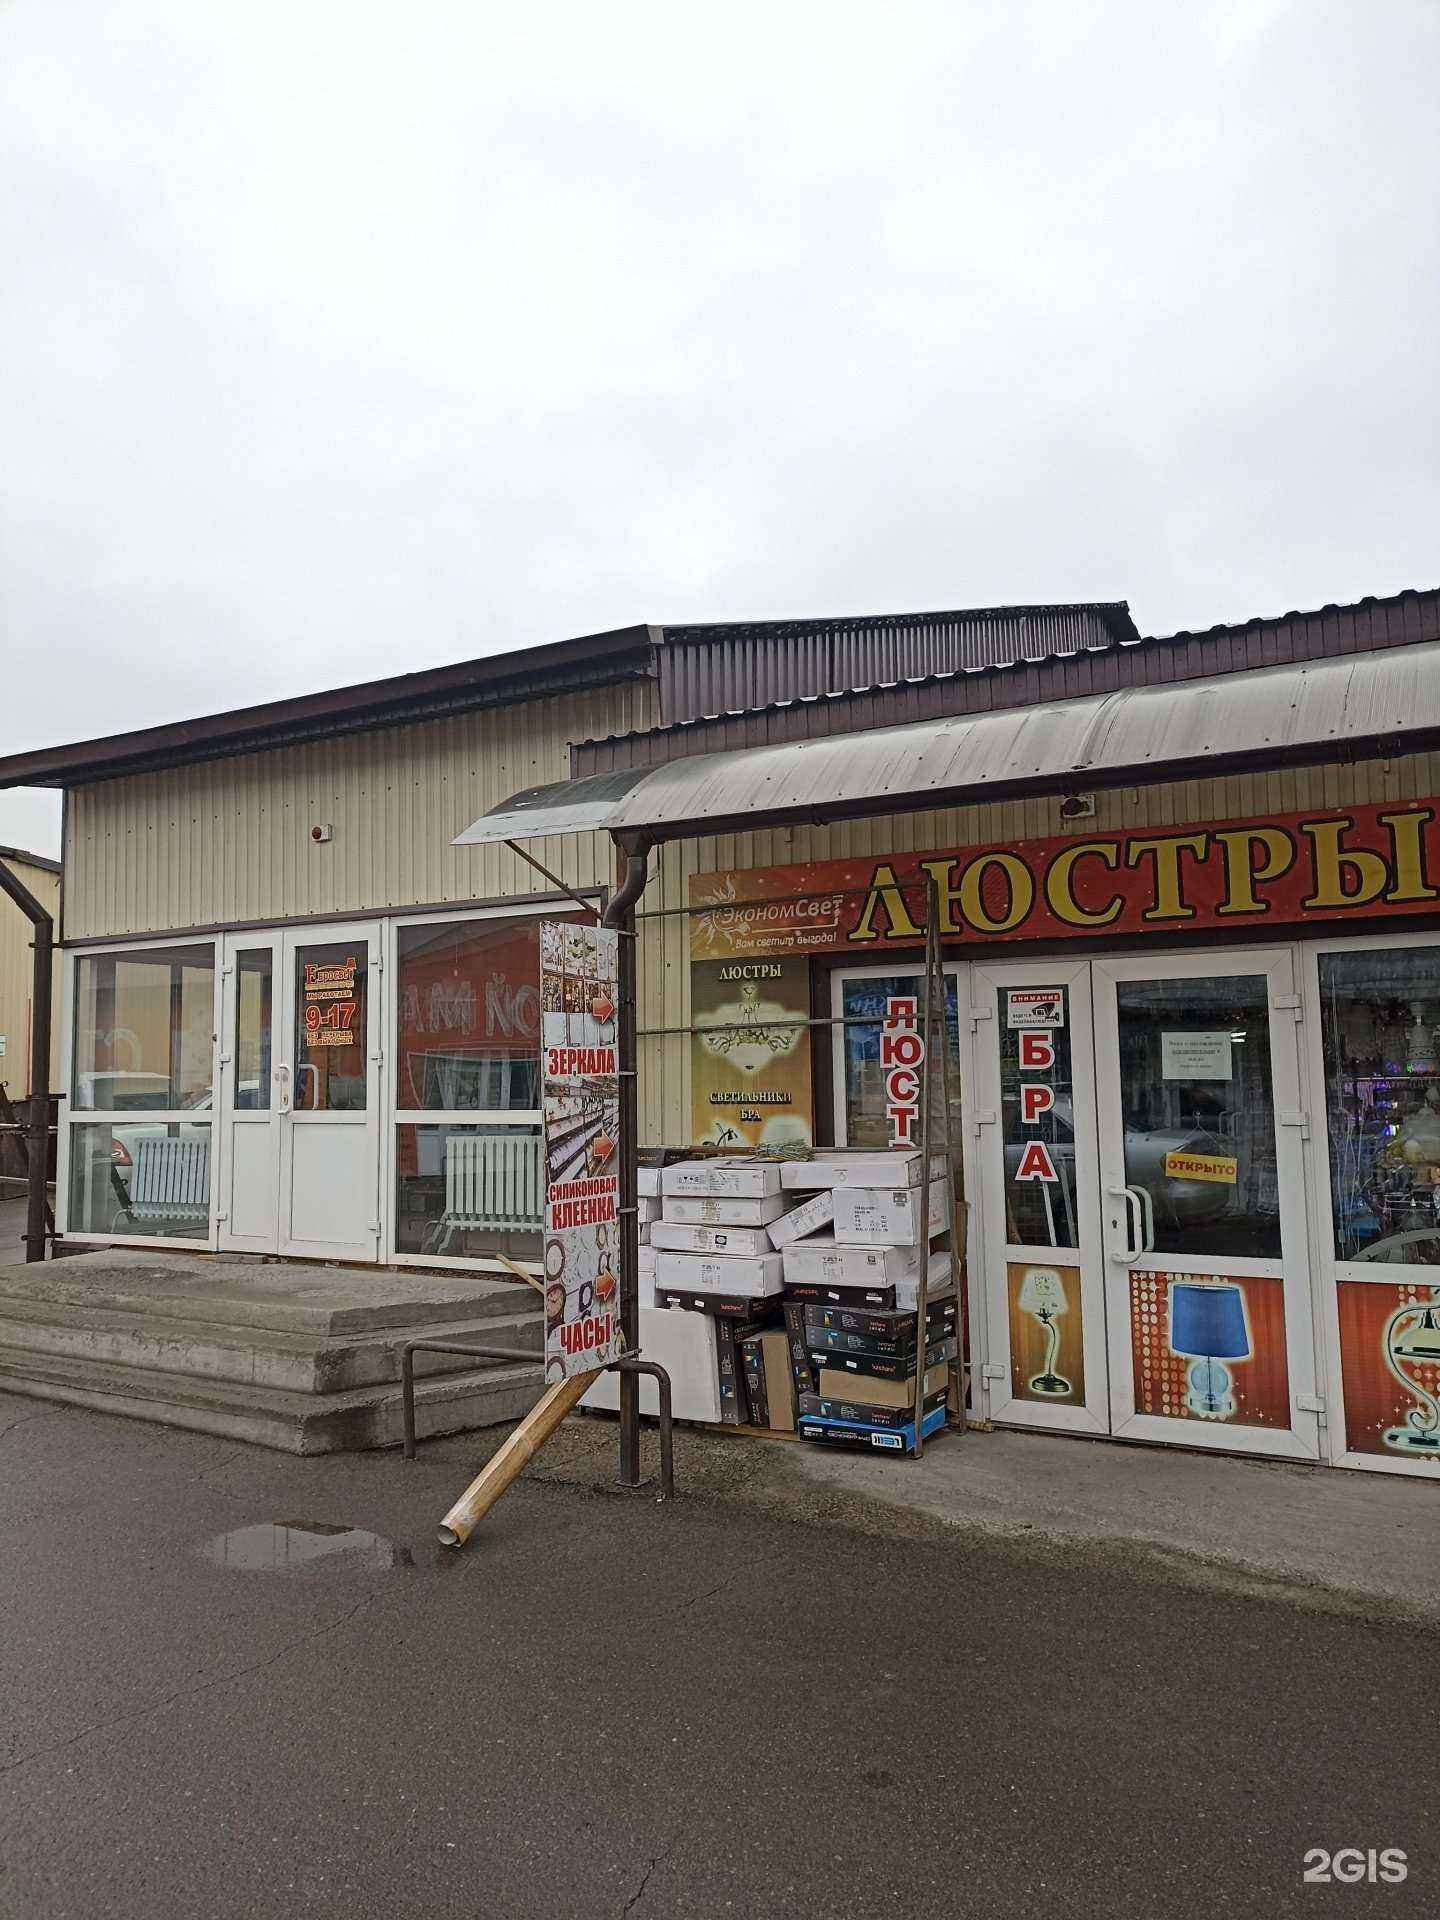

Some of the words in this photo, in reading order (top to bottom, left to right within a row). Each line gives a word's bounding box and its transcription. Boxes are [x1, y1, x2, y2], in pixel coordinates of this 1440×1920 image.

[847, 807, 1440, 942] ЛЮСТРЫ
[736, 938, 754, 950] Вам
[756, 935, 795, 948] светит
[797, 931, 837, 946] выгода!
[719, 964, 782, 980] ЛЮСТРЫ
[1011, 993, 1059, 1003] ВНИМАНИЕ
[306, 1003, 356, 1031] 9-17
[548, 1048, 616, 1075] ЗЕРКАЛА
[880, 997, 925, 1149] ЛЮСТ
[710, 1091, 793, 1104] СВЕТИЛЬНИКИ
[1015, 1030, 1060, 1183] БРА
[741, 1109, 761, 1121] БРА
[1168, 1160, 1235, 1175] ОТКРЫТО
[549, 1177, 617, 1202] СИЛИКОНОВАЯ
[552, 1196, 616, 1231] КЛЕЕНКА
[560, 1314, 611, 1355] ЧАСЫ
